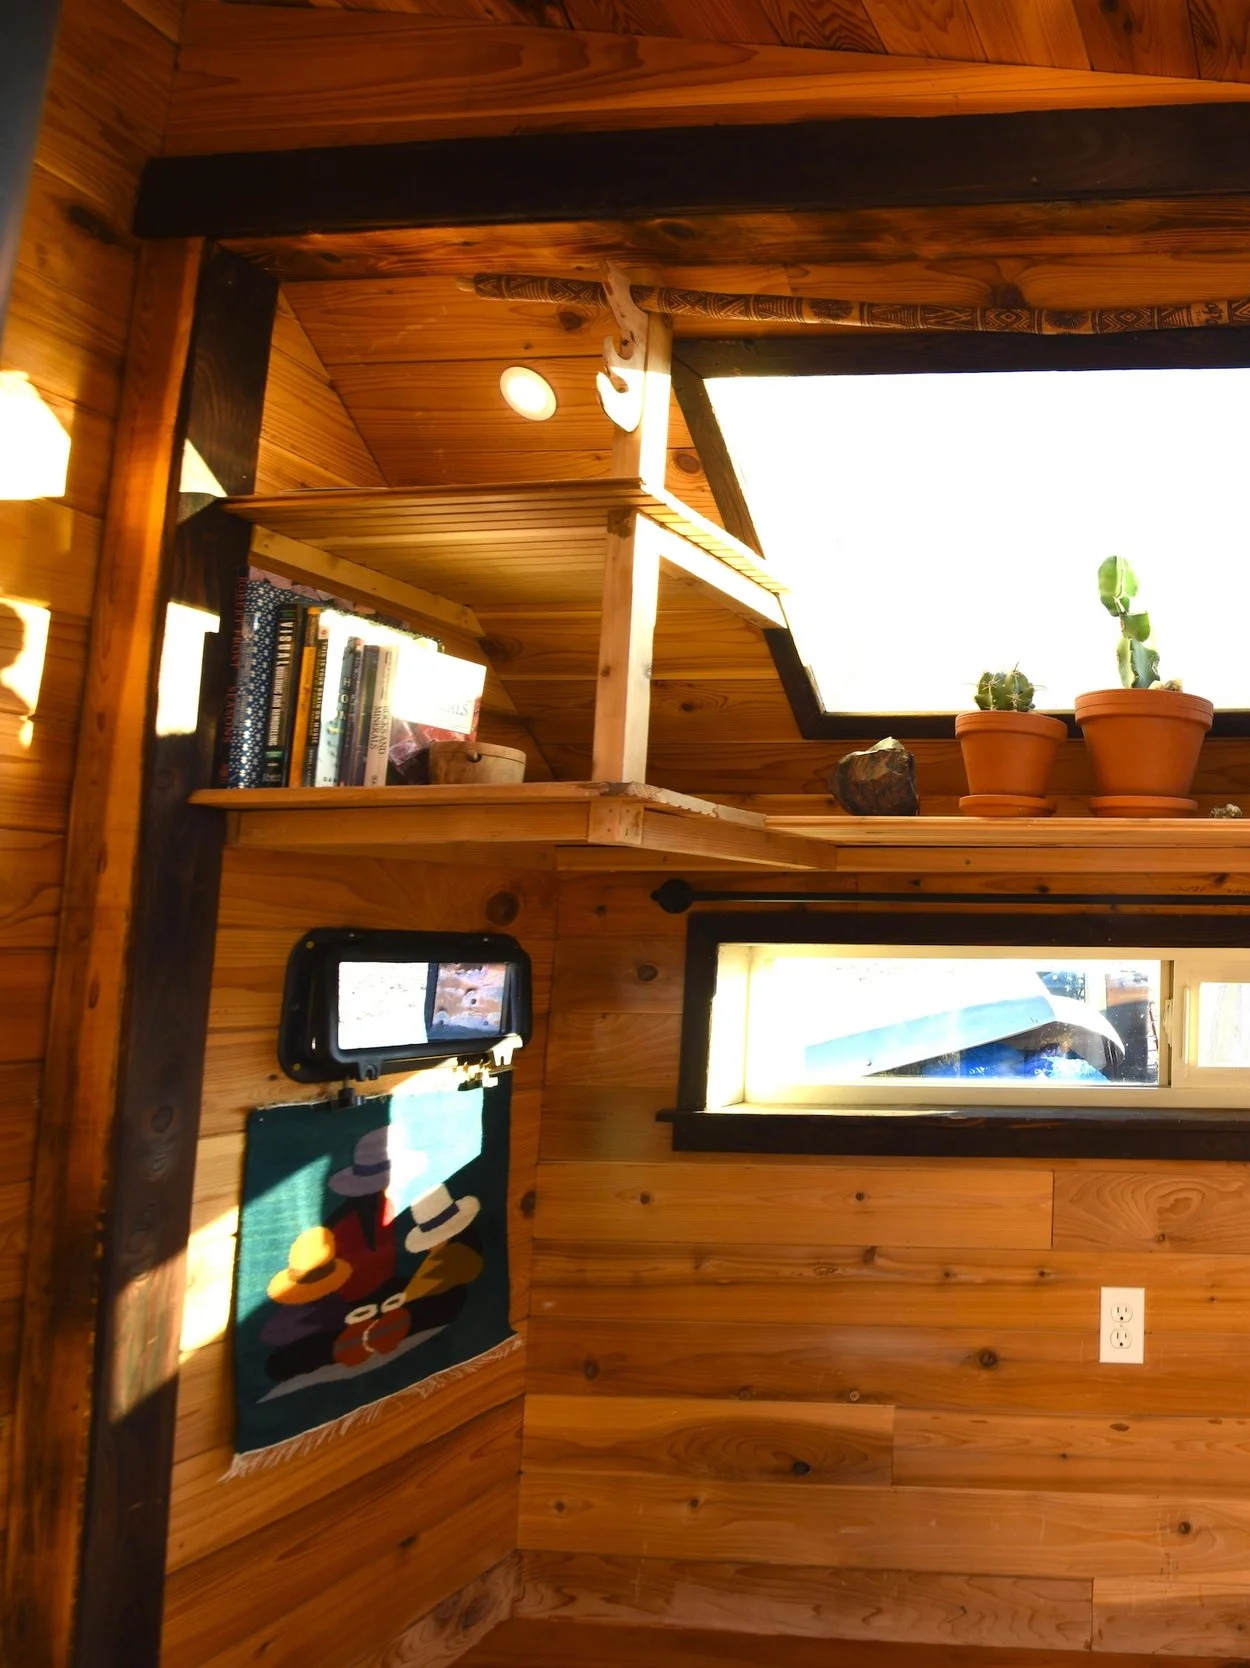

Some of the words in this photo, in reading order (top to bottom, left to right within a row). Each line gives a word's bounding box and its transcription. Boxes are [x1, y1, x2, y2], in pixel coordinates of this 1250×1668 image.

[276, 621, 294, 667] VISUAL
[314, 710, 321, 718] ON
[311, 721, 320, 744] MUSIC
[370, 705, 383, 750] MINERALS
[379, 735, 387, 755] AND
